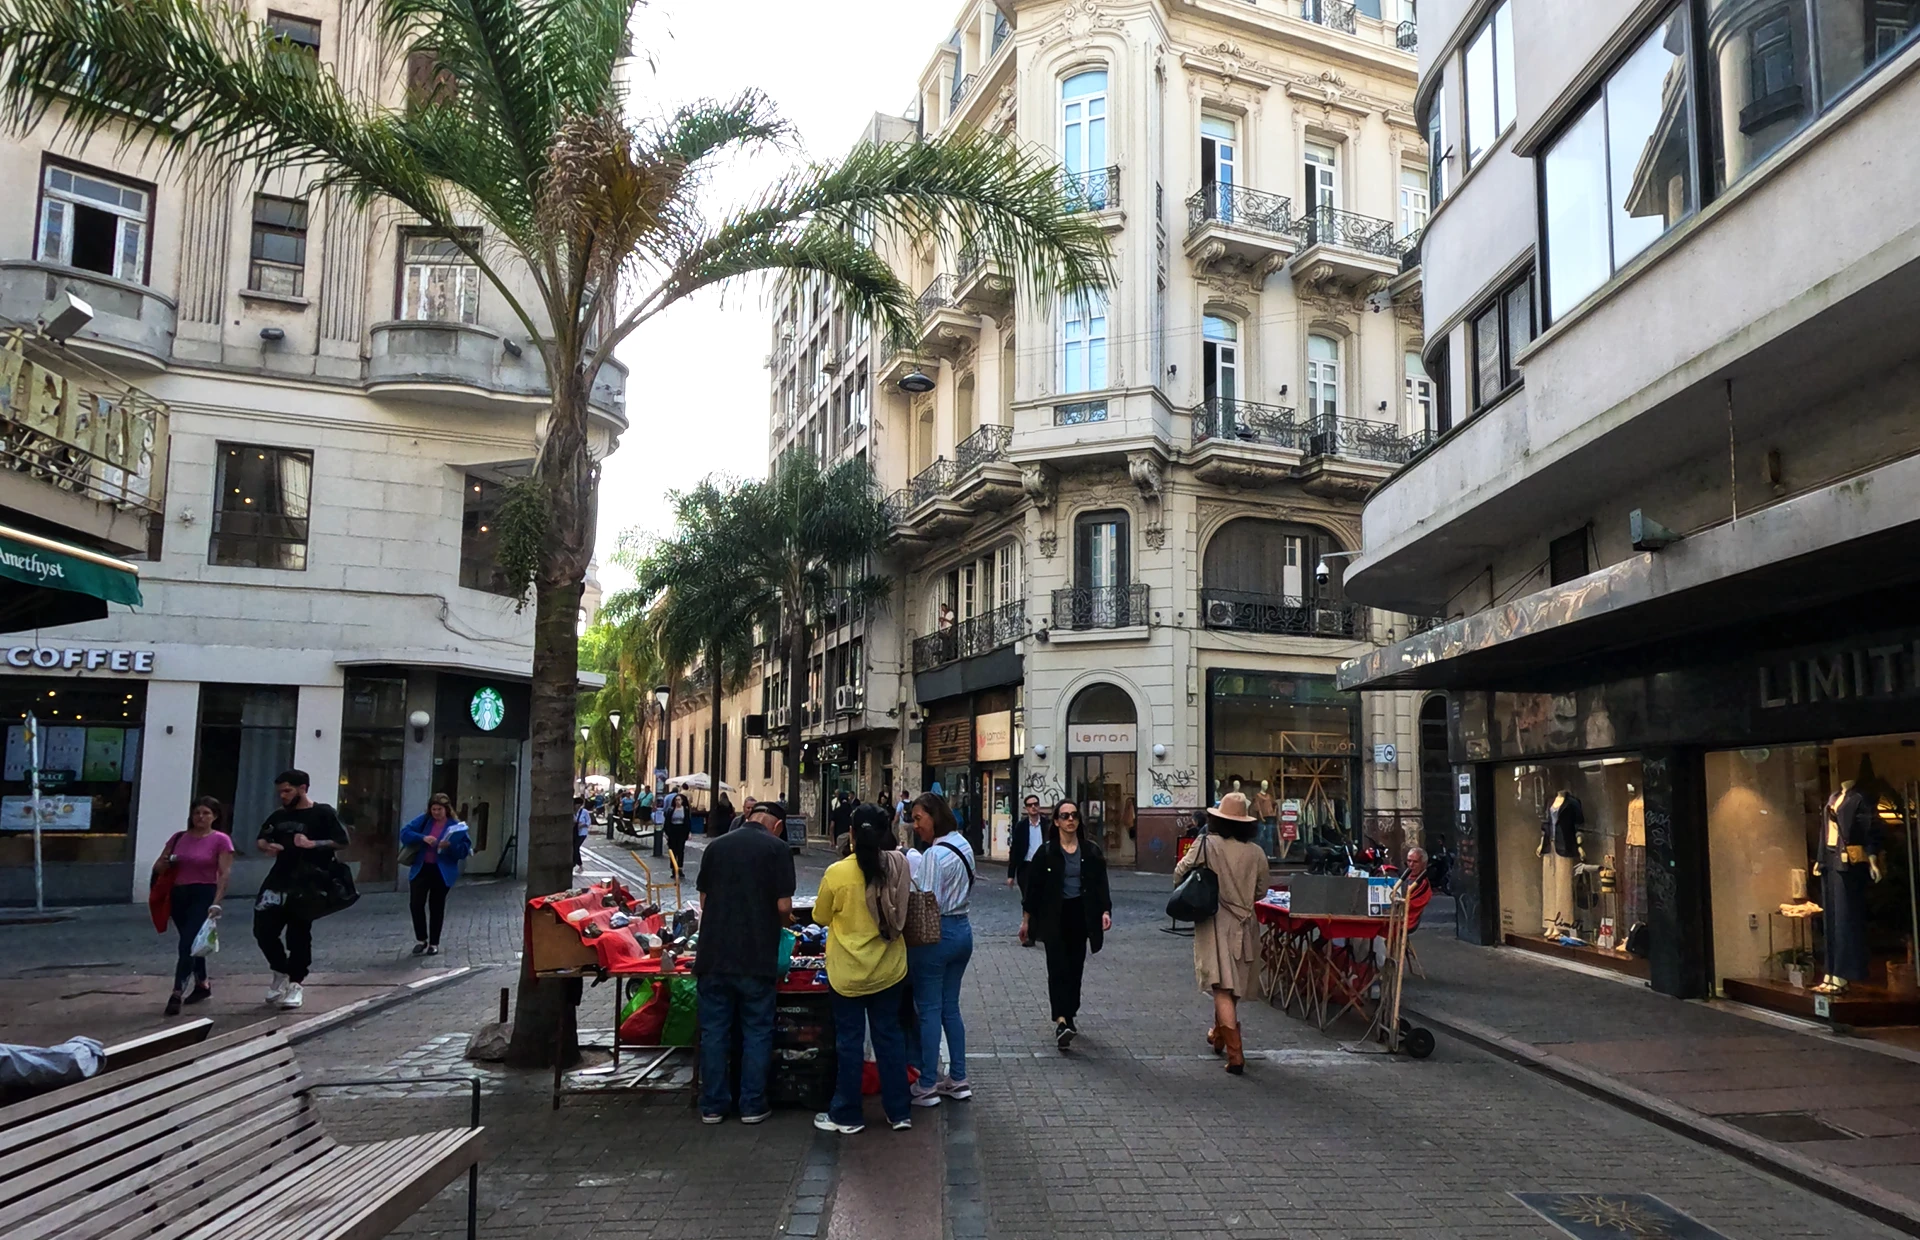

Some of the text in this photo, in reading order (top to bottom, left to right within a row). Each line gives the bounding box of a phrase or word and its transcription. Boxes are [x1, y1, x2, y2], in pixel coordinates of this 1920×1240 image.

[7, 646, 153, 672] COFFEE
[1759, 640, 1920, 709] LIMIT
[1076, 732, 1129, 743] lemon
[1311, 739, 1356, 750] lemon
